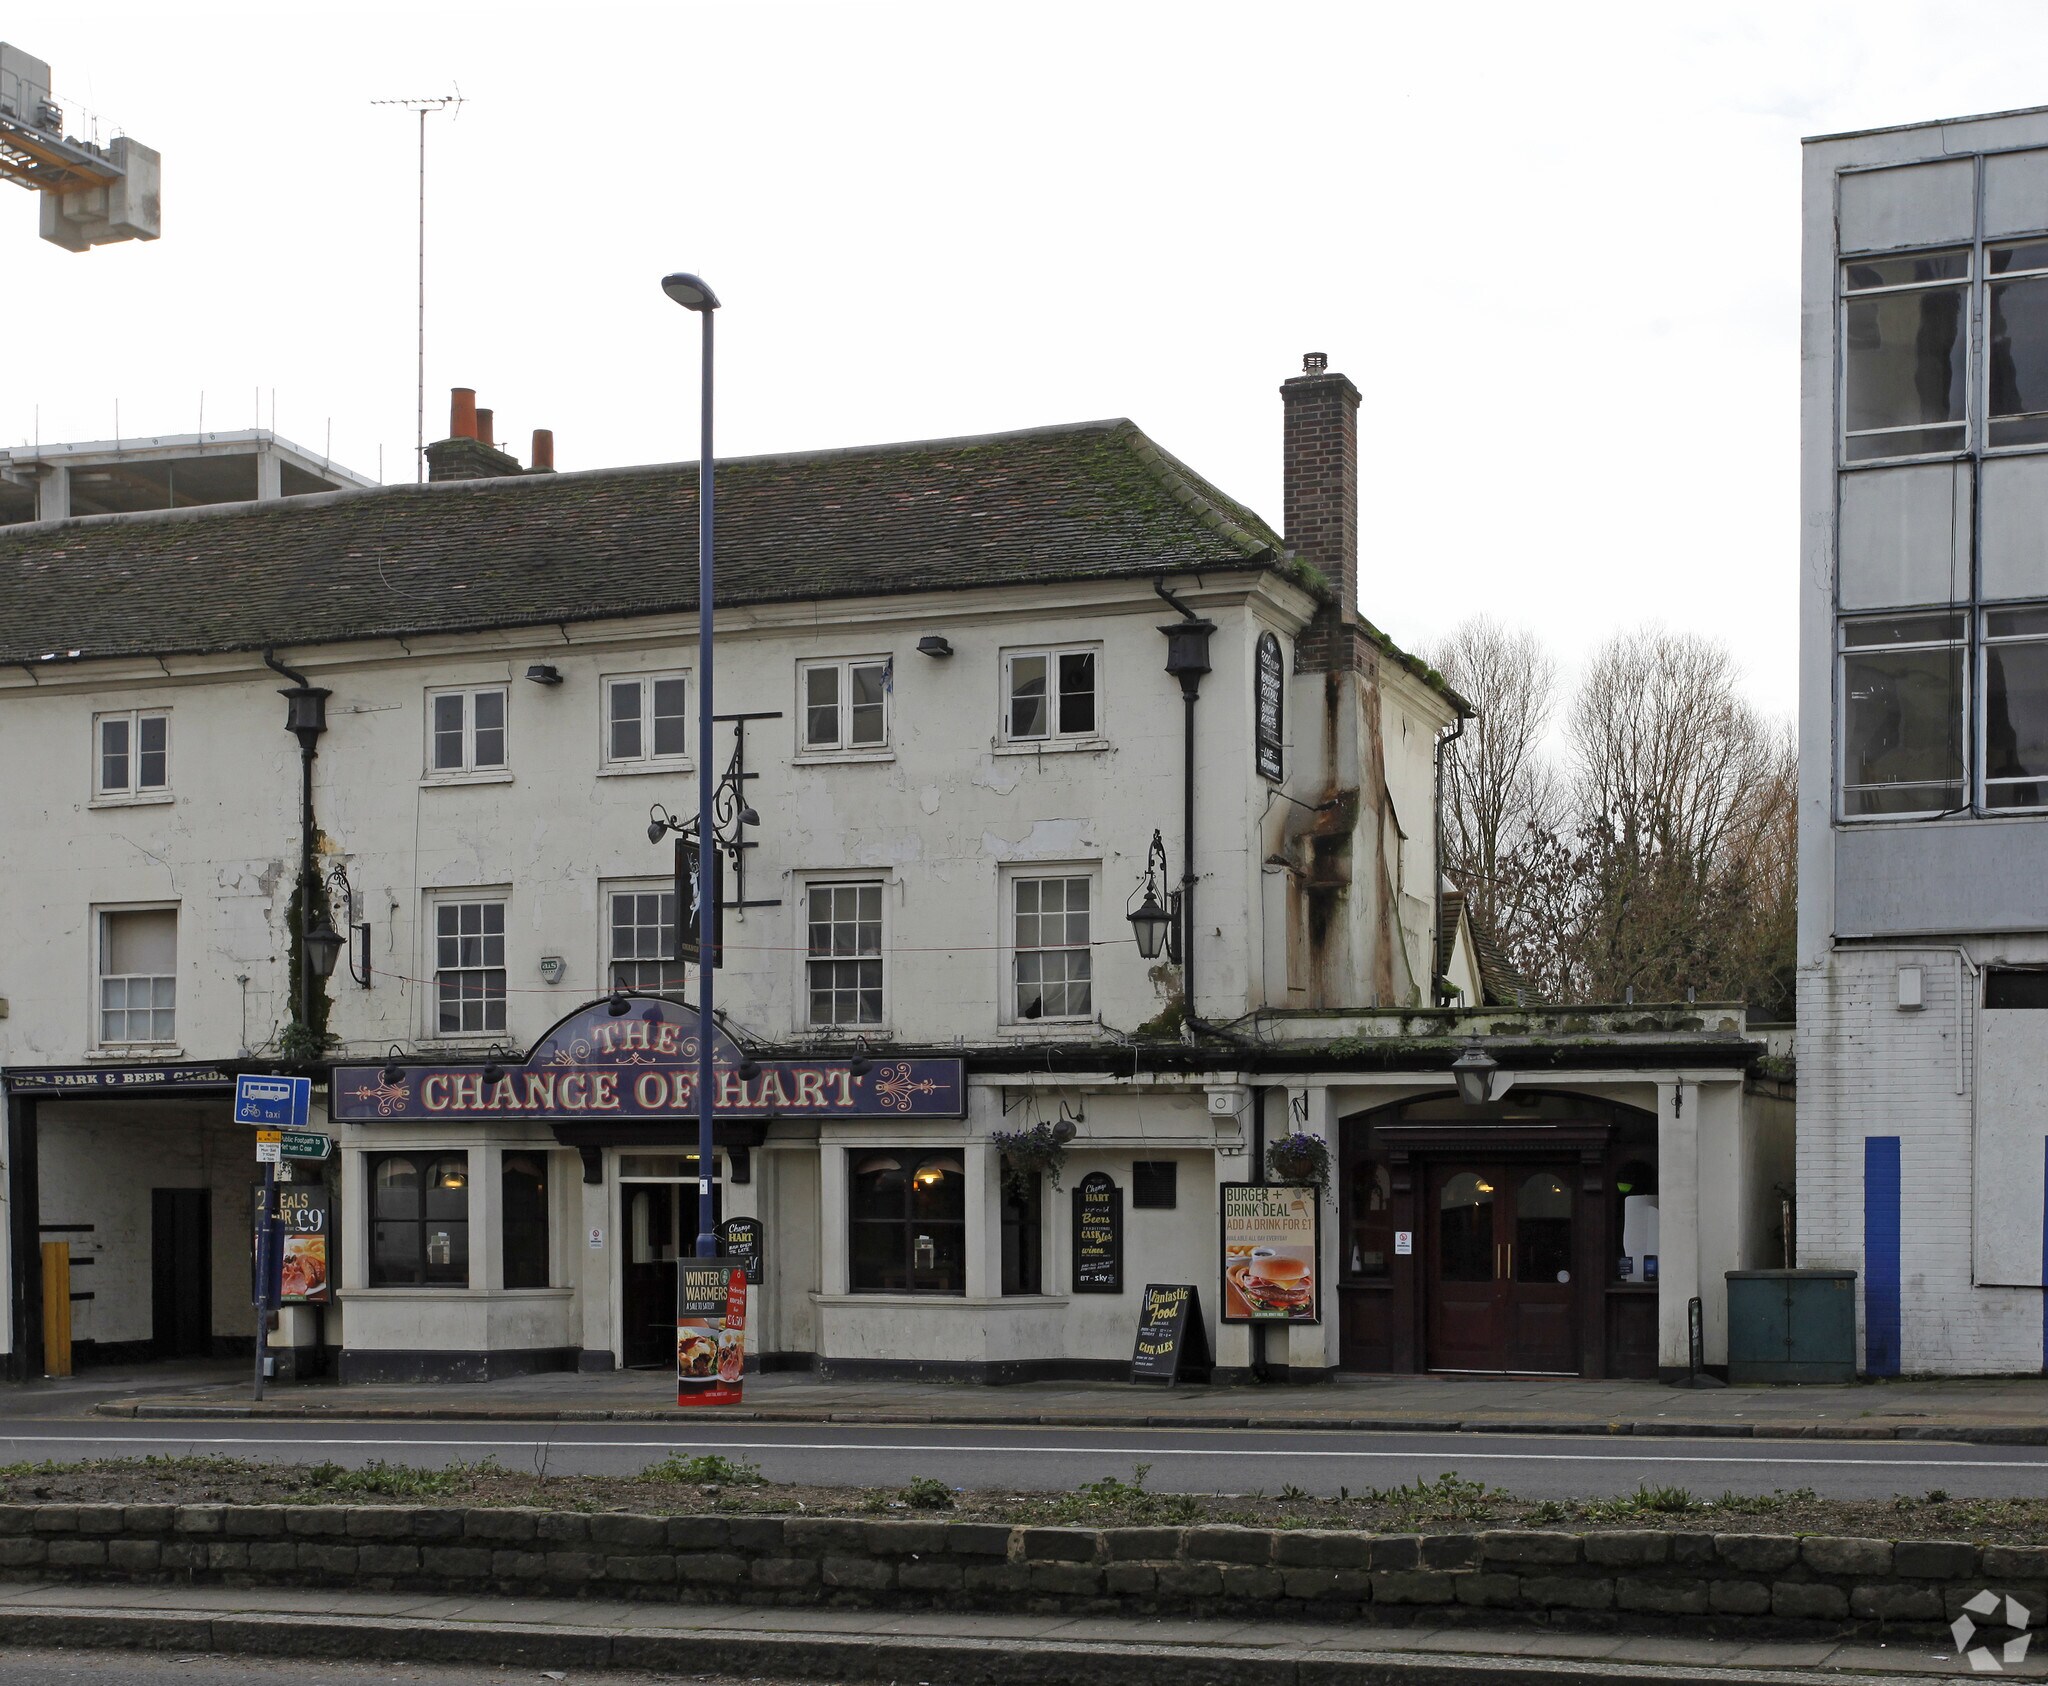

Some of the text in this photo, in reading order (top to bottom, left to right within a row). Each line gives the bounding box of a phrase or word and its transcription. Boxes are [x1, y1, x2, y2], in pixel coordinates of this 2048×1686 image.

[591, 1019, 681, 1056] THE
[53, 1074, 98, 1086] PARK
[105, 1073, 116, 1084] &
[122, 1072, 166, 1084] BEER
[420, 1067, 864, 1111] CHANGE OF HART
[265, 1110, 280, 1119] taxi
[294, 1136, 314, 1145] Footpath
[257, 1189, 309, 1210] 2 EALS
[1085, 1193, 1110, 1202] HART
[1226, 1188, 1269, 1202] BURGER
[1226, 1203, 1290, 1217] DRINK DEAL
[1082, 1213, 1110, 1224] Beers
[1226, 1218, 1245, 1231] ADD
[1246, 1218, 1253, 1231] A
[1254, 1218, 1281, 1231] DRINK
[1282, 1218, 1300, 1231] FOR
[728, 1233, 753, 1242] HART
[1081, 1231, 1100, 1239] CASK
[685, 1271, 719, 1286] WINTER
[1095, 1274, 1108, 1283] sky
[685, 1286, 728, 1301] WARMERS
[1149, 1301, 1179, 1327] Food
[1139, 1340, 1174, 1355] CASK ALES
